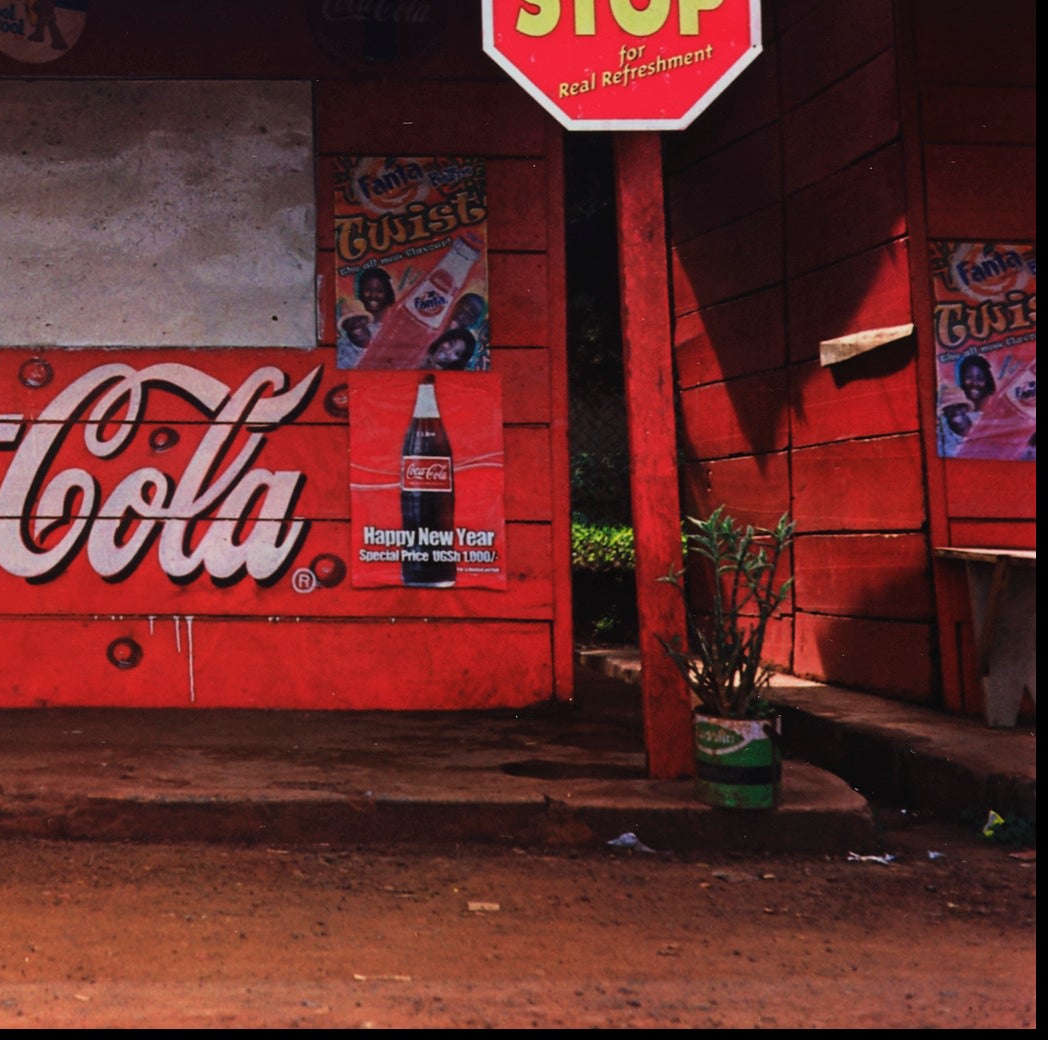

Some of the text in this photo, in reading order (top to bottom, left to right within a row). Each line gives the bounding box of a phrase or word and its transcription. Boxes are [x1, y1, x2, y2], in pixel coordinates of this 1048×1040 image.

[619, 44, 646, 67] for
[558, 44, 713, 98] Real Refreshment
[358, 163, 424, 199] Fanta
[335, 192, 486, 260] Twist
[956, 251, 1023, 286] Fanta
[414, 294, 446, 310] Fanta
[406, 463, 448, 480] Coca-Cola
[363, 526, 494, 548] Happy New Year
[359, 549, 399, 562] Special
[401, 549, 429, 562] Price
[432, 550, 461, 562] UGSh
